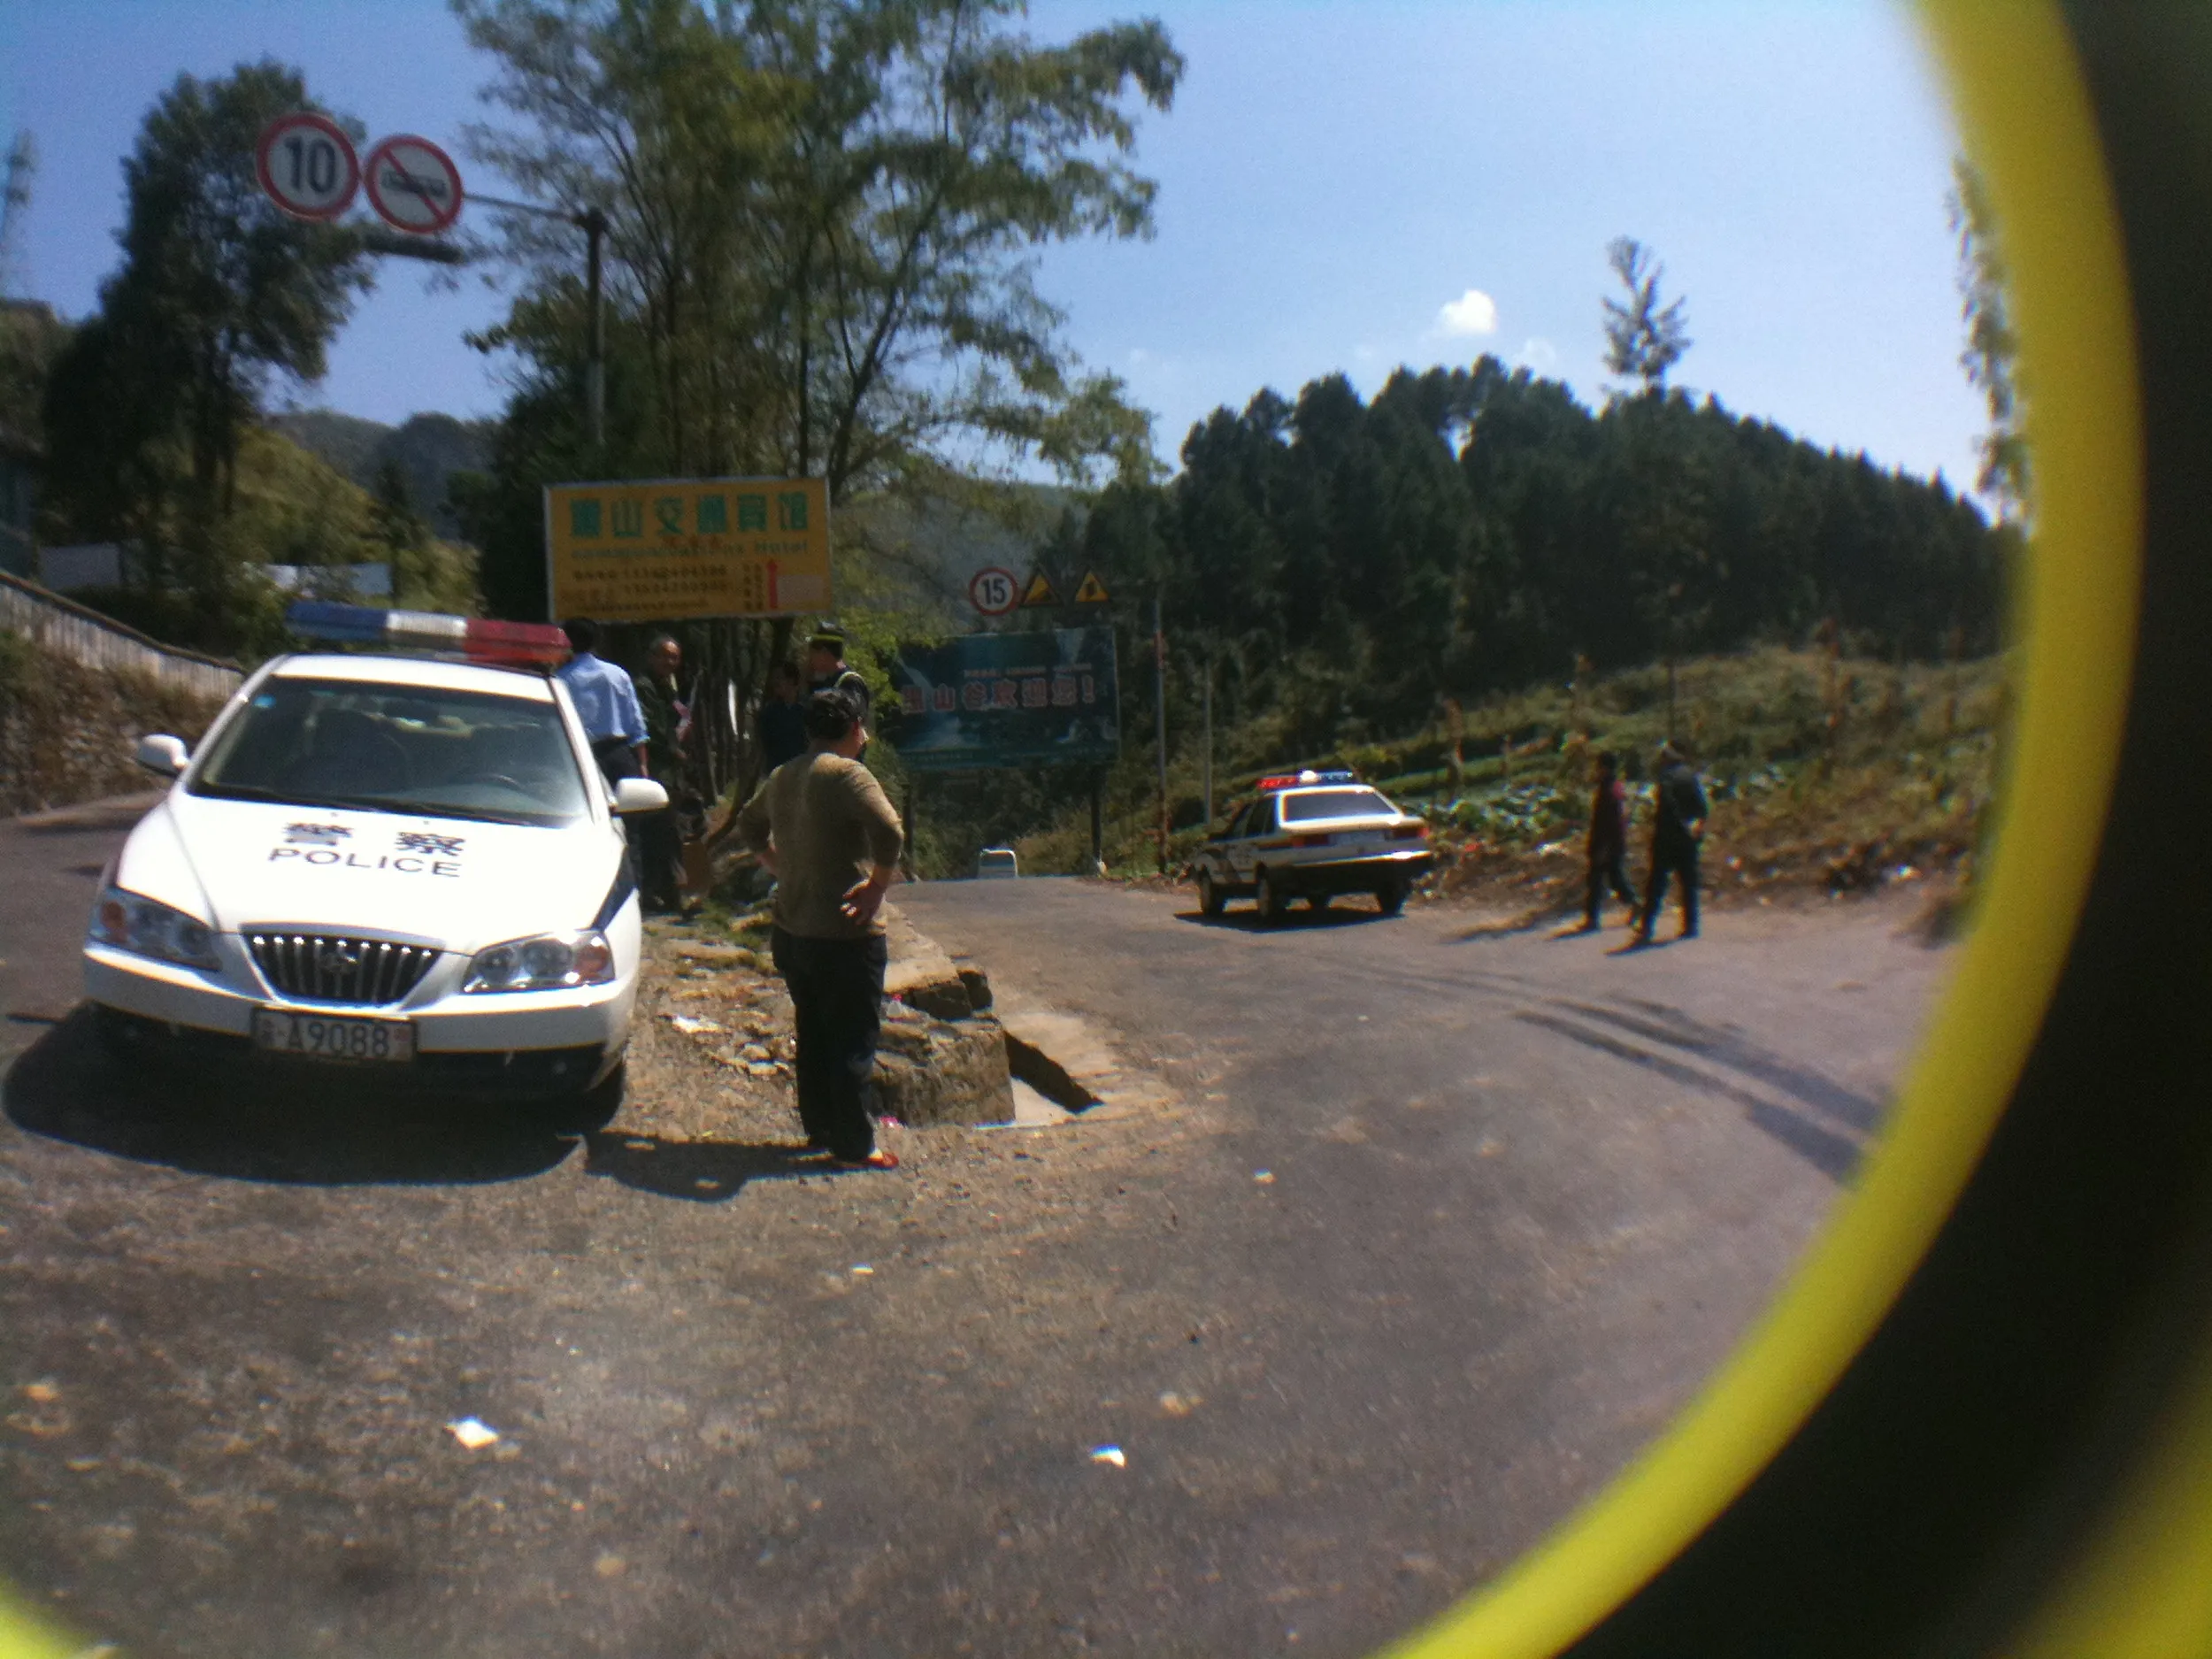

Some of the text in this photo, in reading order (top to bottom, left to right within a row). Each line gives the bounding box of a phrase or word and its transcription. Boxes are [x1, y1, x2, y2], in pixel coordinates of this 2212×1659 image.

[283, 135, 336, 194] 10
[980, 578, 1006, 605] 15
[283, 822, 466, 856] 警察
[268, 847, 463, 878] POLICE
